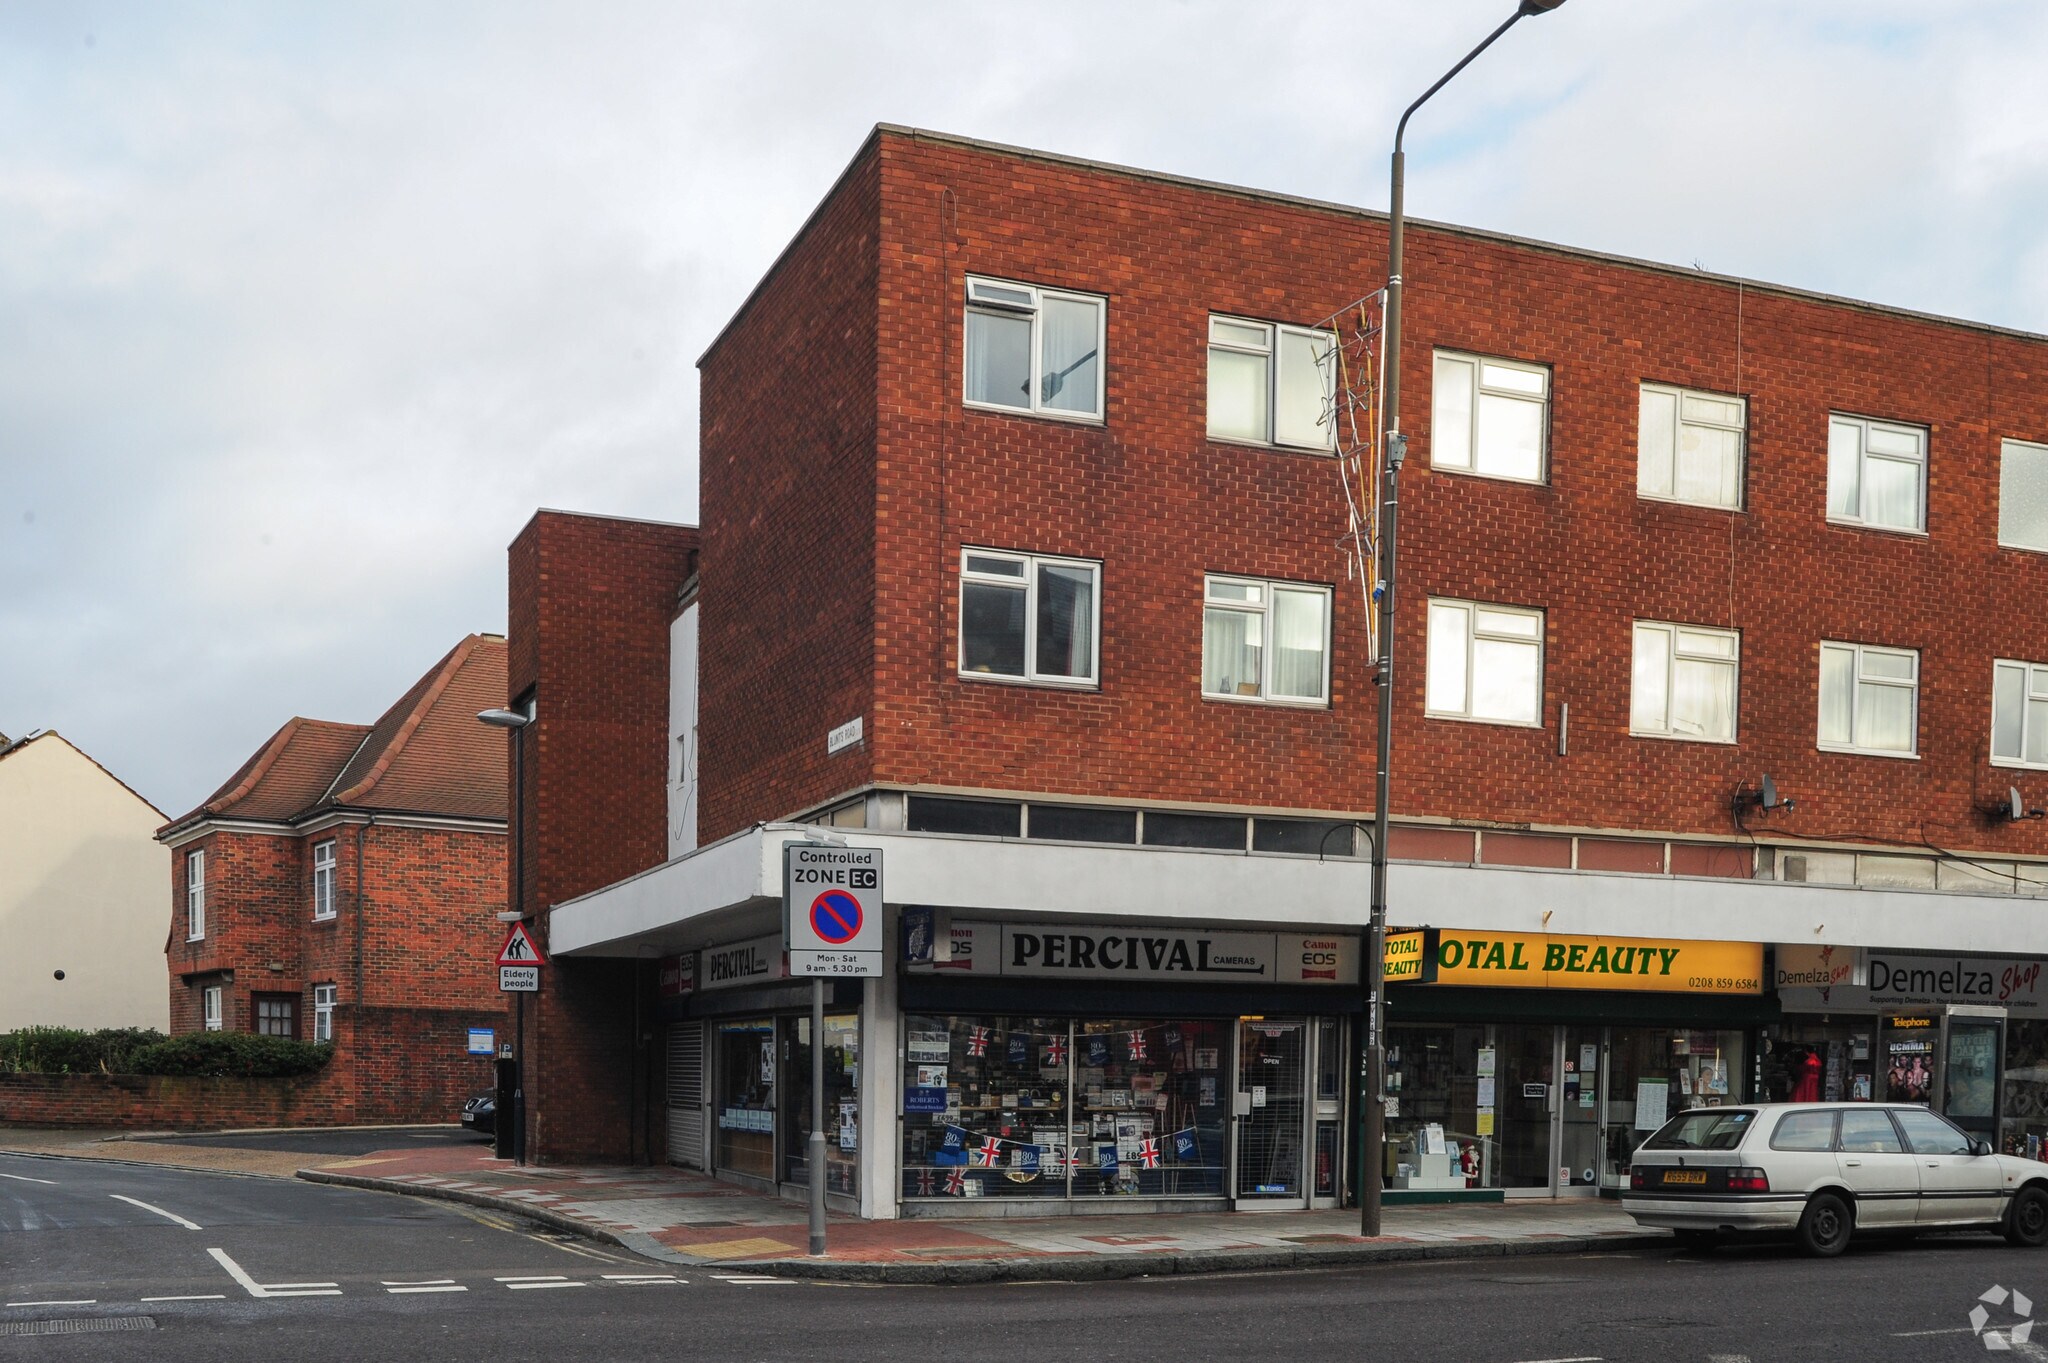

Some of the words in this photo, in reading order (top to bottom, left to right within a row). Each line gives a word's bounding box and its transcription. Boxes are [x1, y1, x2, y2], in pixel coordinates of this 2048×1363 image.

[800, 851, 872, 864] Controlled
[794, 869, 846, 884] ZONE
[852, 871, 875, 886] EC
[951, 929, 973, 937] non
[1303, 940, 1337, 949] Canon
[1385, 939, 1418, 955] TOTAL
[1012, 933, 1213, 972] PERCIVAL
[1213, 956, 1255, 965] CAMERAS
[1438, 939, 1529, 970] OTAL
[1542, 943, 1680, 975] BEAUTY
[711, 947, 758, 981] PERCIVAL
[842, 955, 857, 963] Sat
[1302, 953, 1336, 965] EOS
[504, 970, 534, 979] Elderly
[832, 965, 853, 973] 5.30
[1778, 968, 1830, 984] Demelza
[1830, 964, 1850, 985] Shop
[504, 980, 534, 988] people
[1688, 977, 1714, 988] 0208
[1716, 978, 1733, 989] 859
[1736, 978, 1758, 990] 6584
[1870, 960, 1994, 995] Demelza
[1999, 962, 2041, 1000] Shop
[1892, 1017, 1931, 1028] Telephone
[503, 1044, 510, 1052] P
[1889, 1042, 1924, 1052] UCMMA
